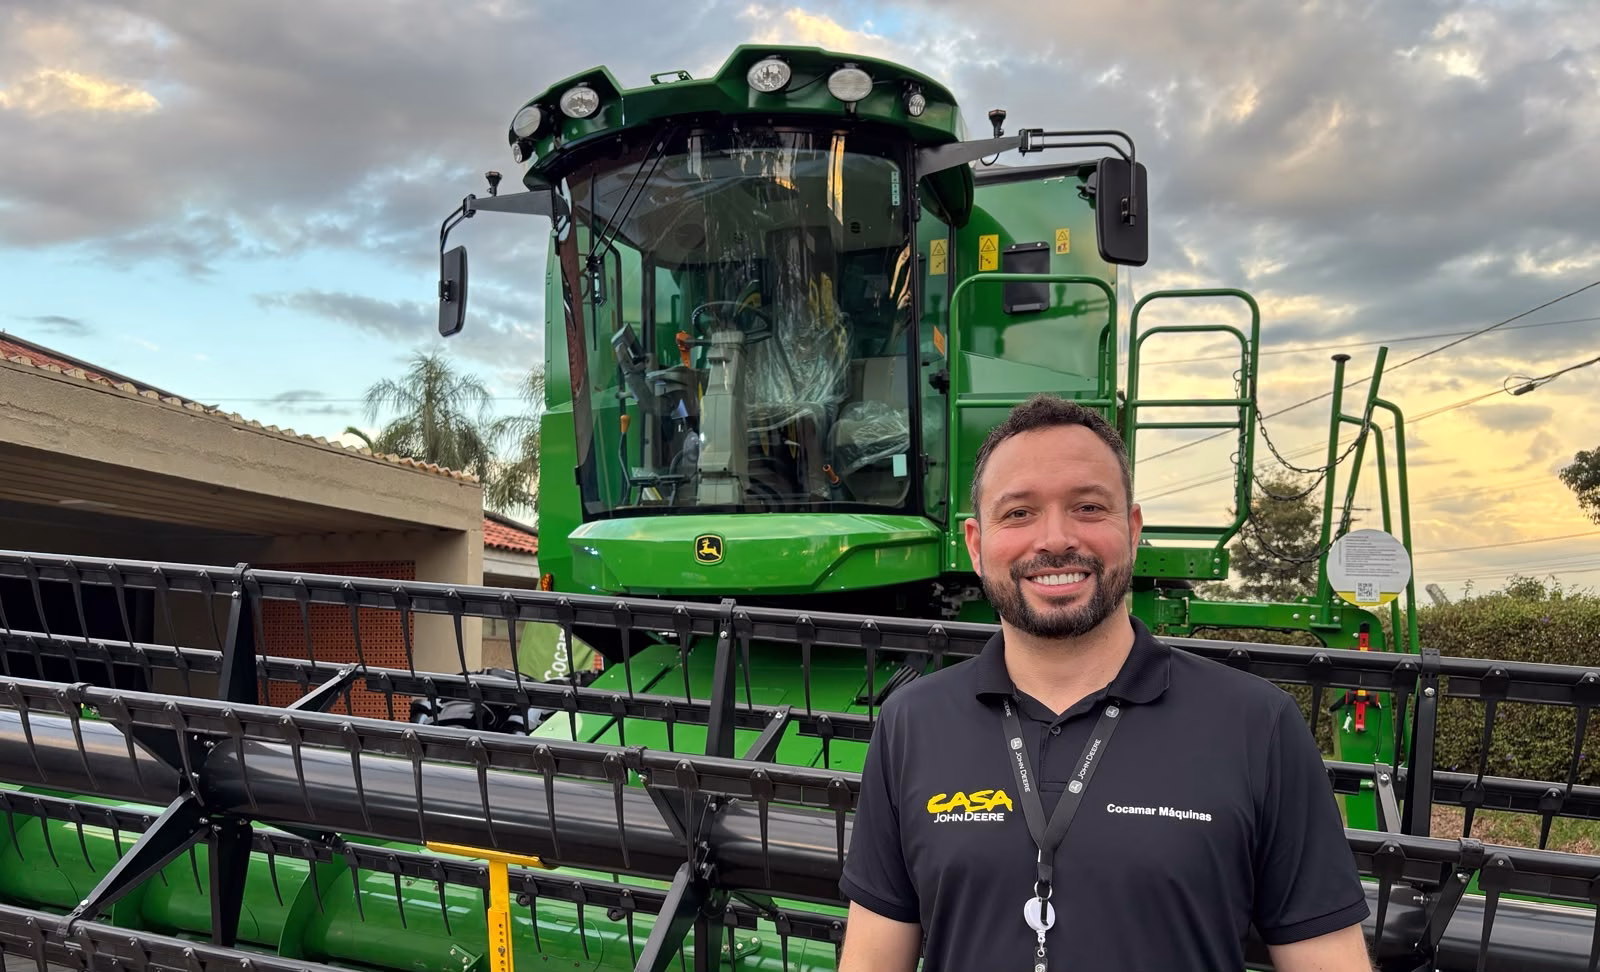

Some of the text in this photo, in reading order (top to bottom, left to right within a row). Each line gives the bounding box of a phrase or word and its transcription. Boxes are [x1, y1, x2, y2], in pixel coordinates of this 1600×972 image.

[1078, 739, 1101, 779] JOHN DEERE
[1015, 752, 1030, 792] JOHN DEERE
[927, 789, 1013, 813] CASA
[1106, 803, 1212, 821] Cocamar Máquinas
[933, 811, 1005, 823] JOHN DEERE
